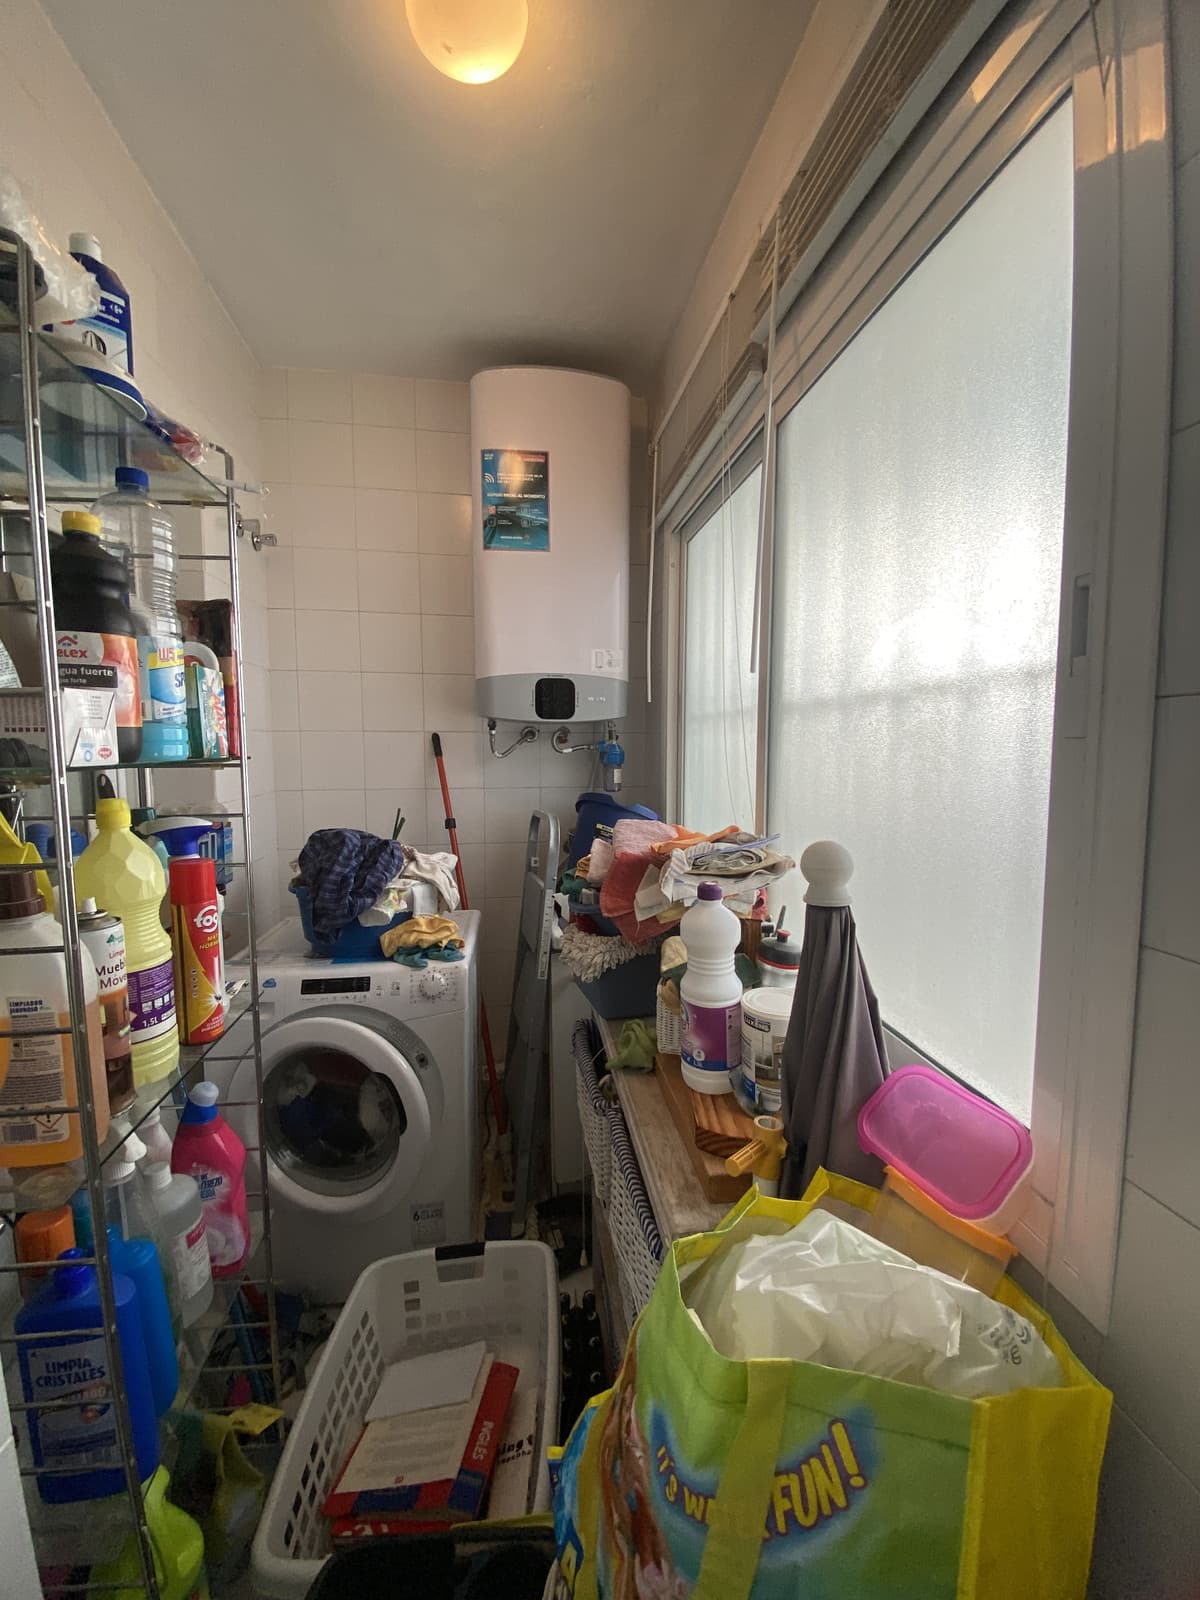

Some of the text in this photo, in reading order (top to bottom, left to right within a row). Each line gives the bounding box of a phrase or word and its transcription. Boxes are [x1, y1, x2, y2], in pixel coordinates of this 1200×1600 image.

[80, 666, 114, 677] fuerte
[45, 1358, 92, 1374] LIMPIA
[36, 1366, 106, 1388] CRISTALES
[771, 1420, 866, 1535] FUN!
